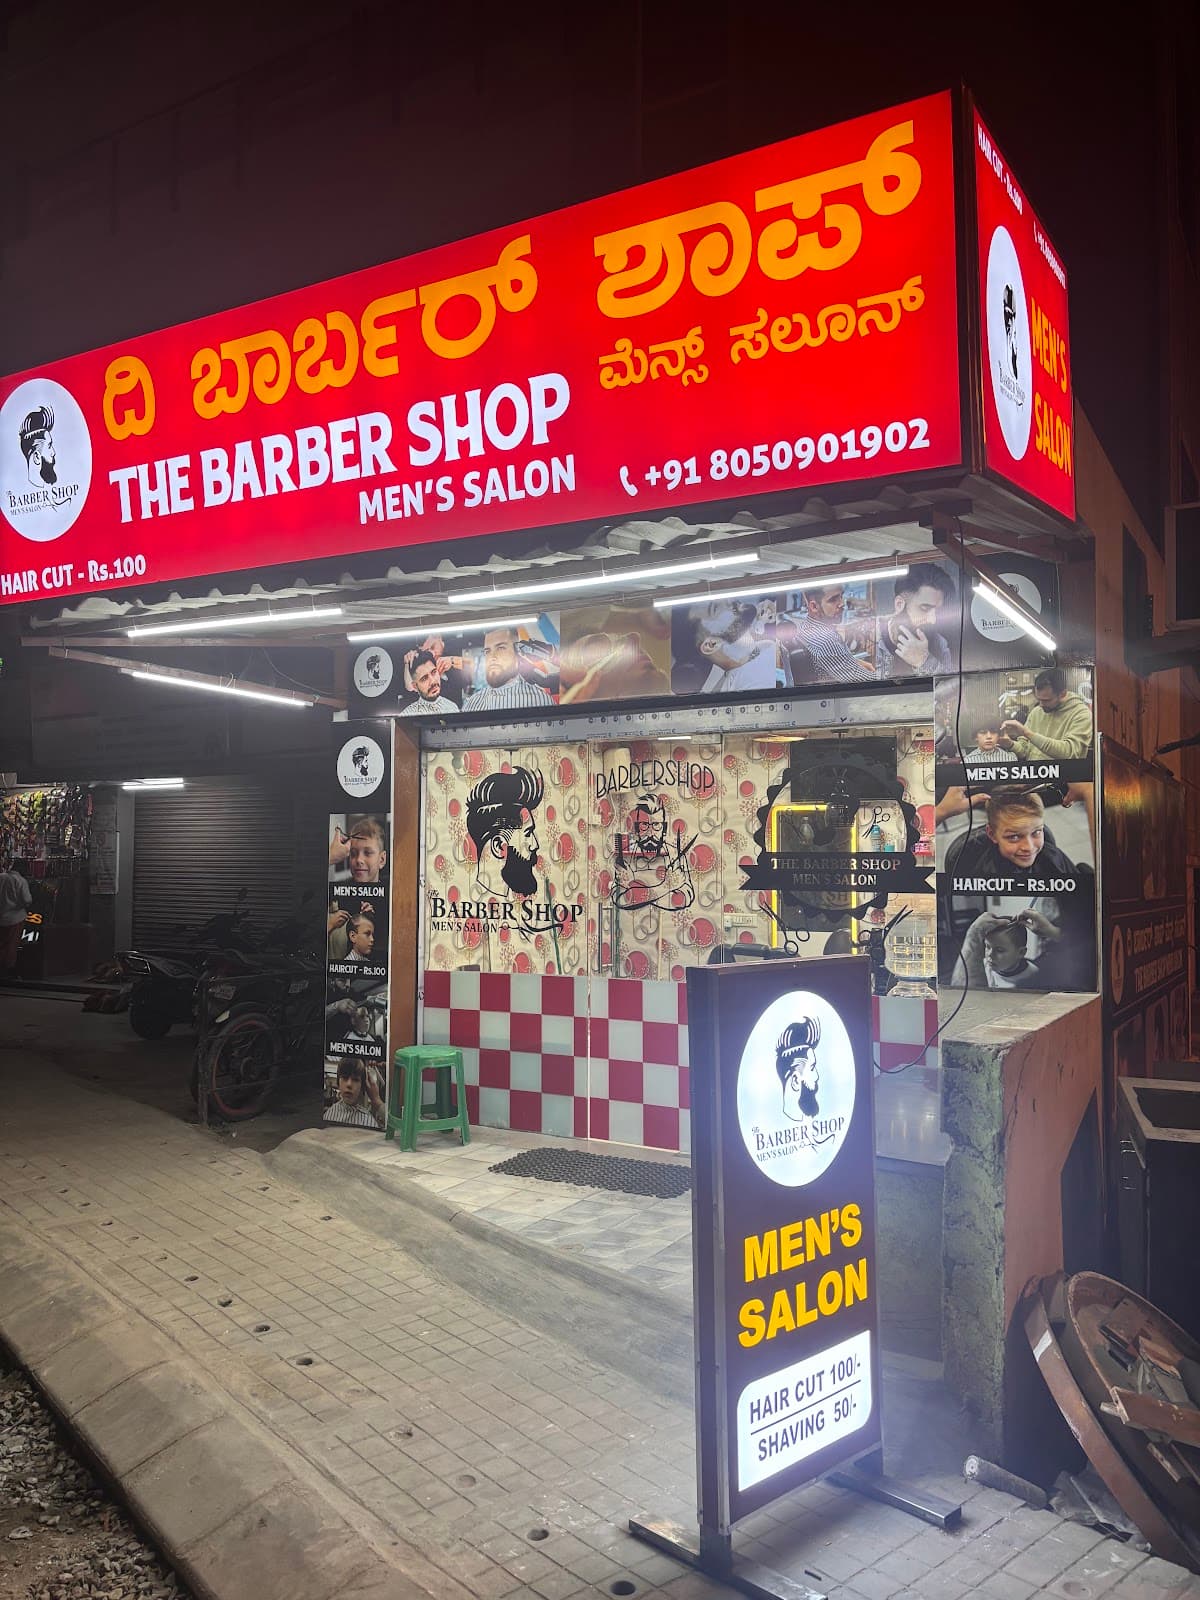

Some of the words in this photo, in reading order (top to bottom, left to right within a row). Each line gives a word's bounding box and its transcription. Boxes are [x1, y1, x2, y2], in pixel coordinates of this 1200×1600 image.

[103, 355, 156, 441] ದಿ
[190, 234, 538, 420] ಬಾರ್ಬರ್
[593, 119, 922, 319] ಶಾಪ್
[598, 325, 709, 390] ಮೆನ್ಸ್
[729, 274, 926, 365] ಸಲೂನ್
[1031, 296, 1068, 394] MEN'S
[108, 455, 195, 524] THE
[199, 411, 394, 508] BARBER
[406, 372, 572, 468] SHOP
[644, 456, 702, 491] +91
[709, 417, 931, 481] 8050901902
[1033, 391, 1072, 478] SALON
[358, 473, 456, 525] MEN'S
[462, 454, 577, 509] SALON
[0, 569, 39, 596] HAIR
[41, 563, 74, 590] CUT
[87, 554, 147, 583] Rs.100
[595, 758, 715, 798] BARBERSHOP
[966, 766, 1009, 782] MEN'S
[1010, 764, 1060, 780] SALON
[333, 886, 357, 898] MEN'S
[357, 886, 385, 898] SALON
[803, 858, 857, 870] BARBER
[861, 858, 901, 871] SHOP
[834, 873, 877, 886] SALON
[953, 877, 1015, 892] HAIRCUT
[431, 921, 462, 932] MEN'S
[464, 921, 499, 933] SALON
[328, 963, 359, 974] HAIRCUT
[330, 1042, 354, 1055] MEN'S
[354, 1044, 382, 1058] SALON
[744, 1203, 862, 1283] MEN'S
[737, 1257, 868, 1348] SALON
[749, 1386, 790, 1425] HAIR
[795, 1369, 825, 1402] CUT
[830, 1353, 862, 1386] 100/-
[758, 1409, 825, 1462] SHAVING
[833, 1393, 858, 1424] 50/-
